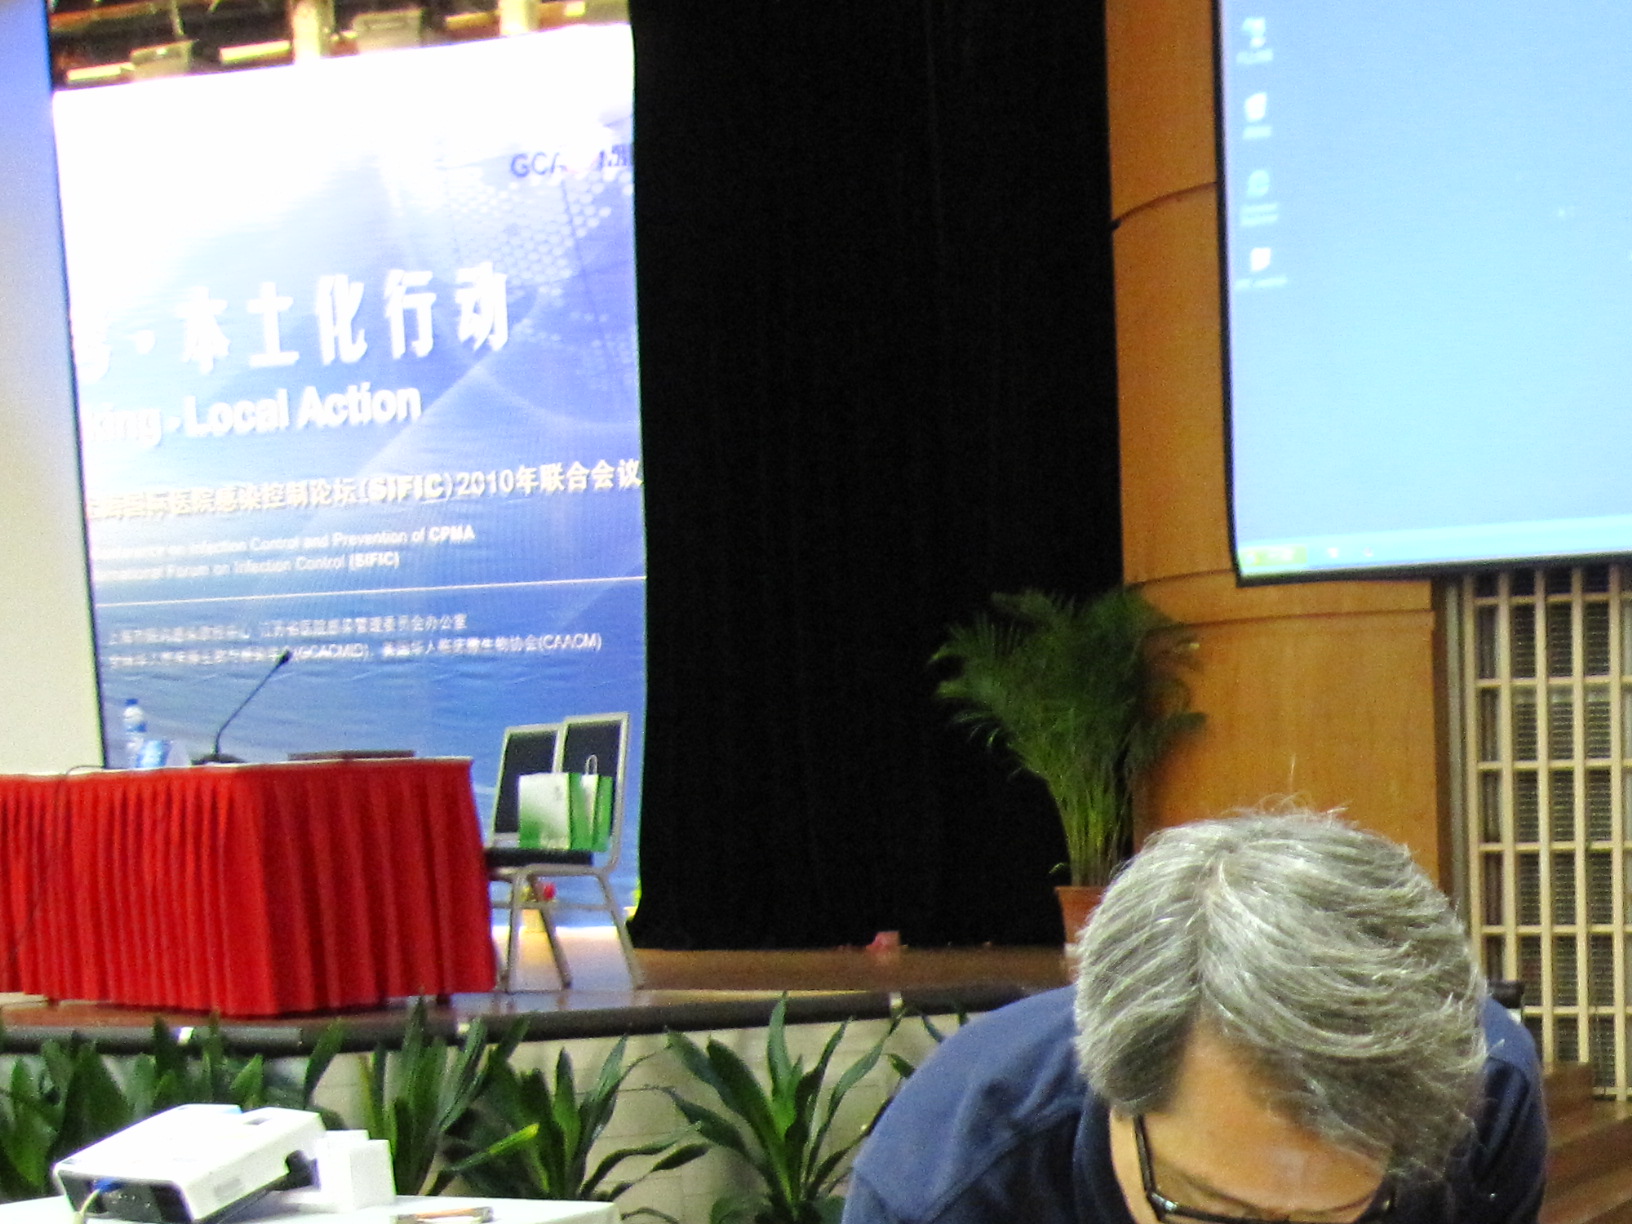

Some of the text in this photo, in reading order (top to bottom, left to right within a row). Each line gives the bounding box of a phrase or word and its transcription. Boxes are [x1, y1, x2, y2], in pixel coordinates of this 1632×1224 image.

[184, 388, 290, 437] Local
[296, 381, 422, 428] Action
[250, 535, 299, 551] Control
[304, 533, 329, 549] and
[331, 530, 408, 547] Prevention
[428, 524, 476, 543] CPMA
[295, 554, 346, 571] Control
